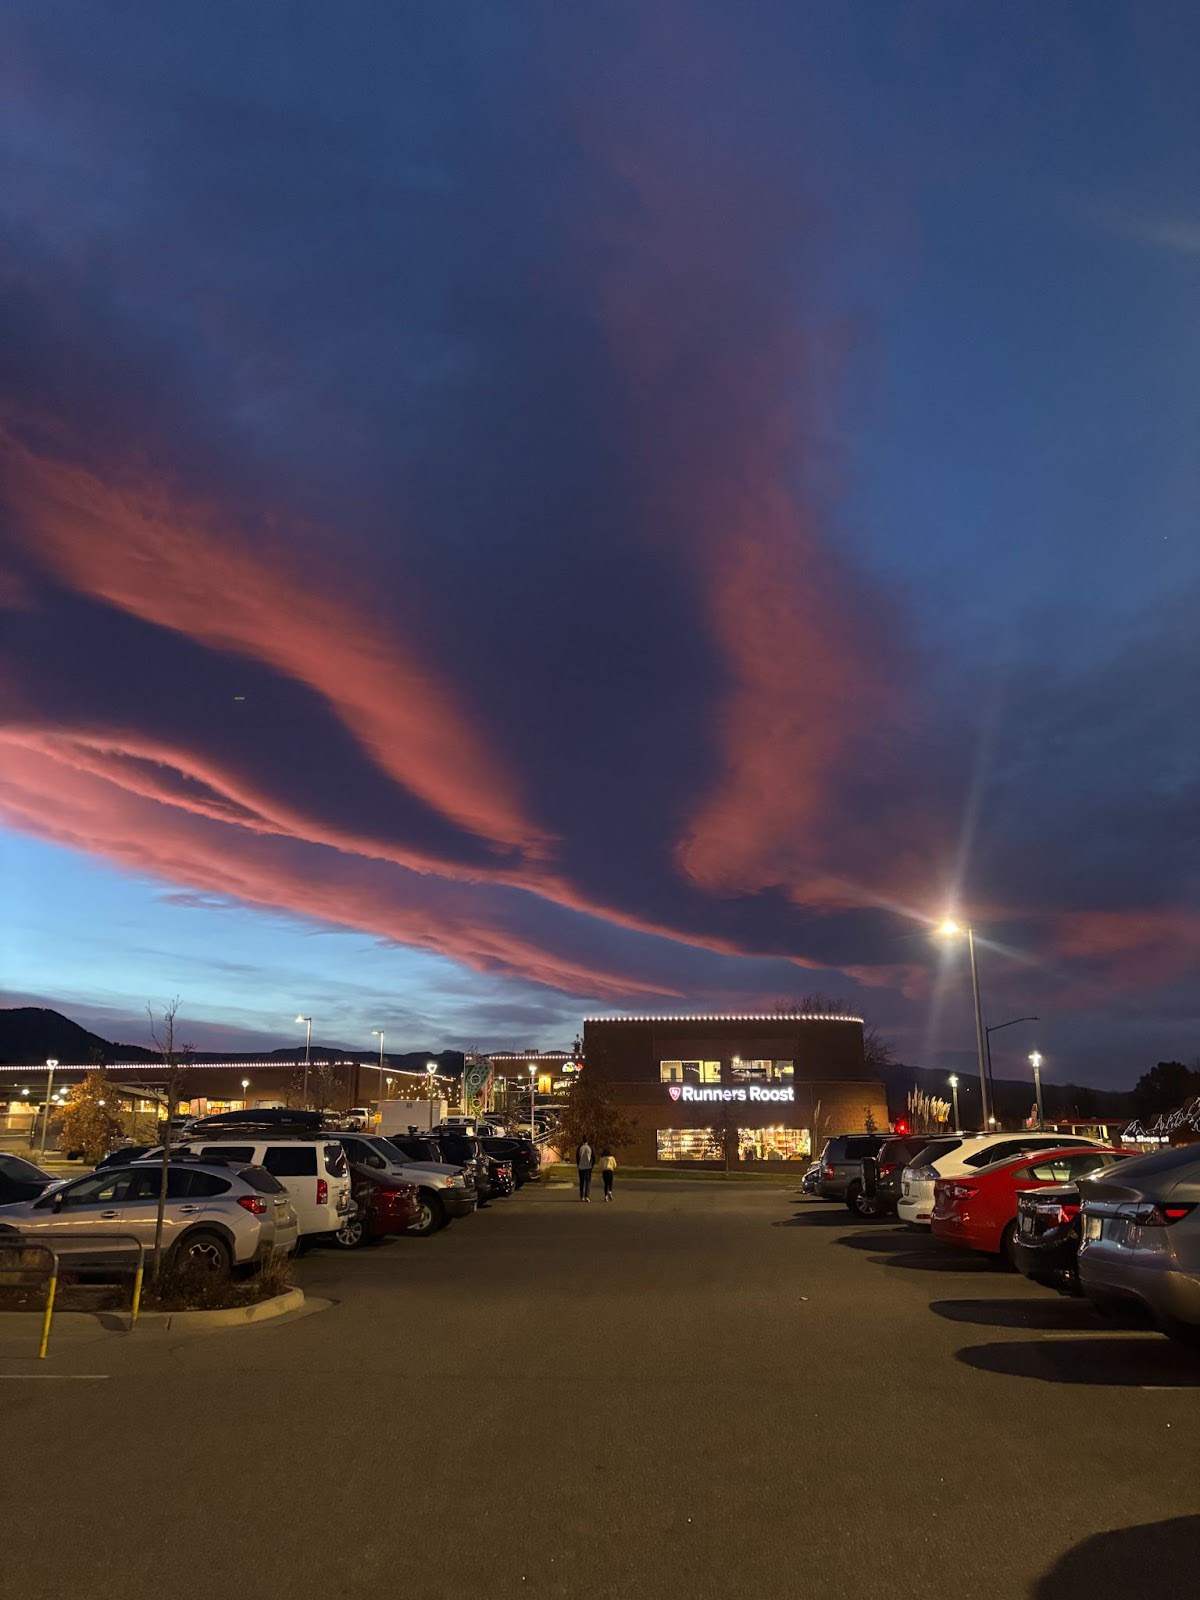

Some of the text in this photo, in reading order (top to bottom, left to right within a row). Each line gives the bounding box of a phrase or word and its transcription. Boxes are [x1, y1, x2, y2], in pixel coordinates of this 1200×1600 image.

[682, 1086, 794, 1101] Runners Roost
[1120, 1135, 1169, 1144] The Shops at
